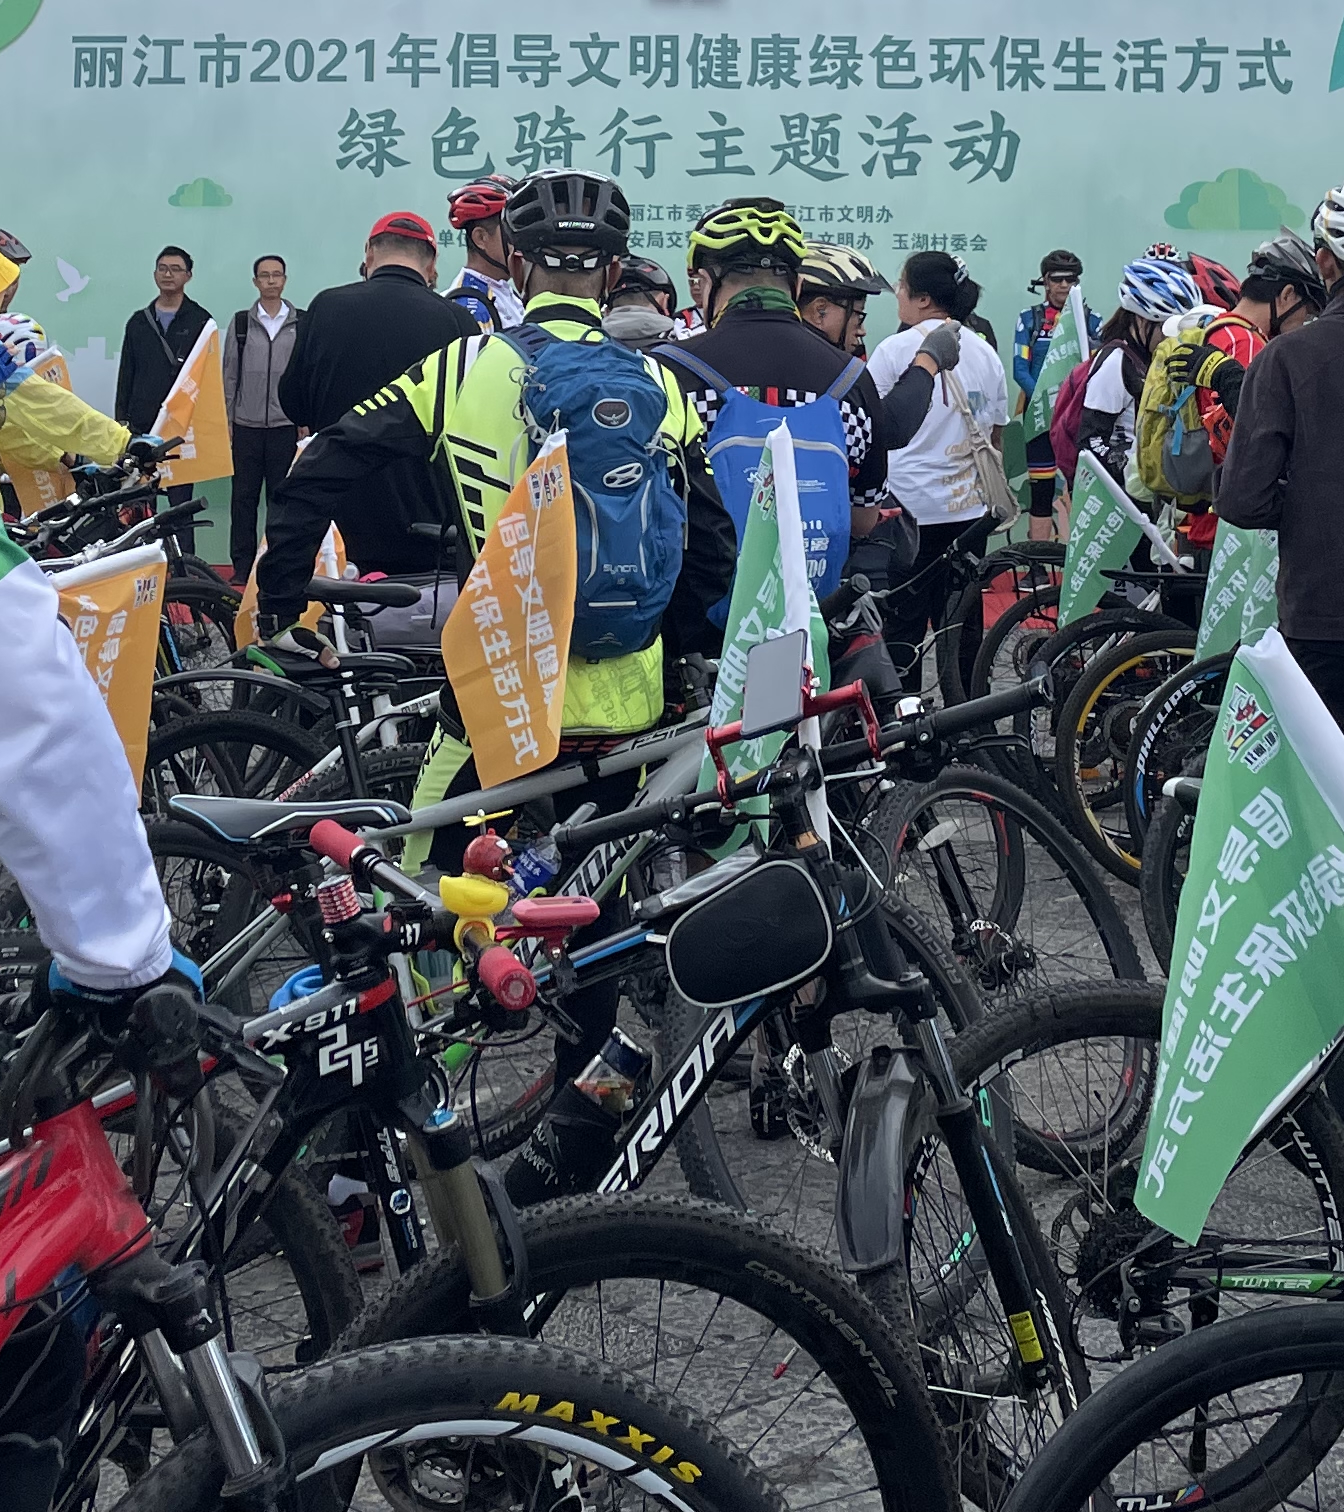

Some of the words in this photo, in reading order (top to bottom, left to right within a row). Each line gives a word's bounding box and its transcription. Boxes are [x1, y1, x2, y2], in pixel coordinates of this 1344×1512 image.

[71, 32, 1294, 96] 丽江市2021年倡导文明健康绿色环保生活方式
[336, 107, 1022, 185] 绿色骑行主题活动
[892, 233, 988, 253] 玉湖村委会
[1136, 679, 1197, 775] PHILLIPS
[262, 997, 356, 1050] X-911
[596, 1006, 737, 1194] ERIDA
[1231, 1276, 1313, 1290] TWITTER
[745, 1260, 898, 1410] CONTINENTAL
[494, 1391, 703, 1485] MAXXIS
